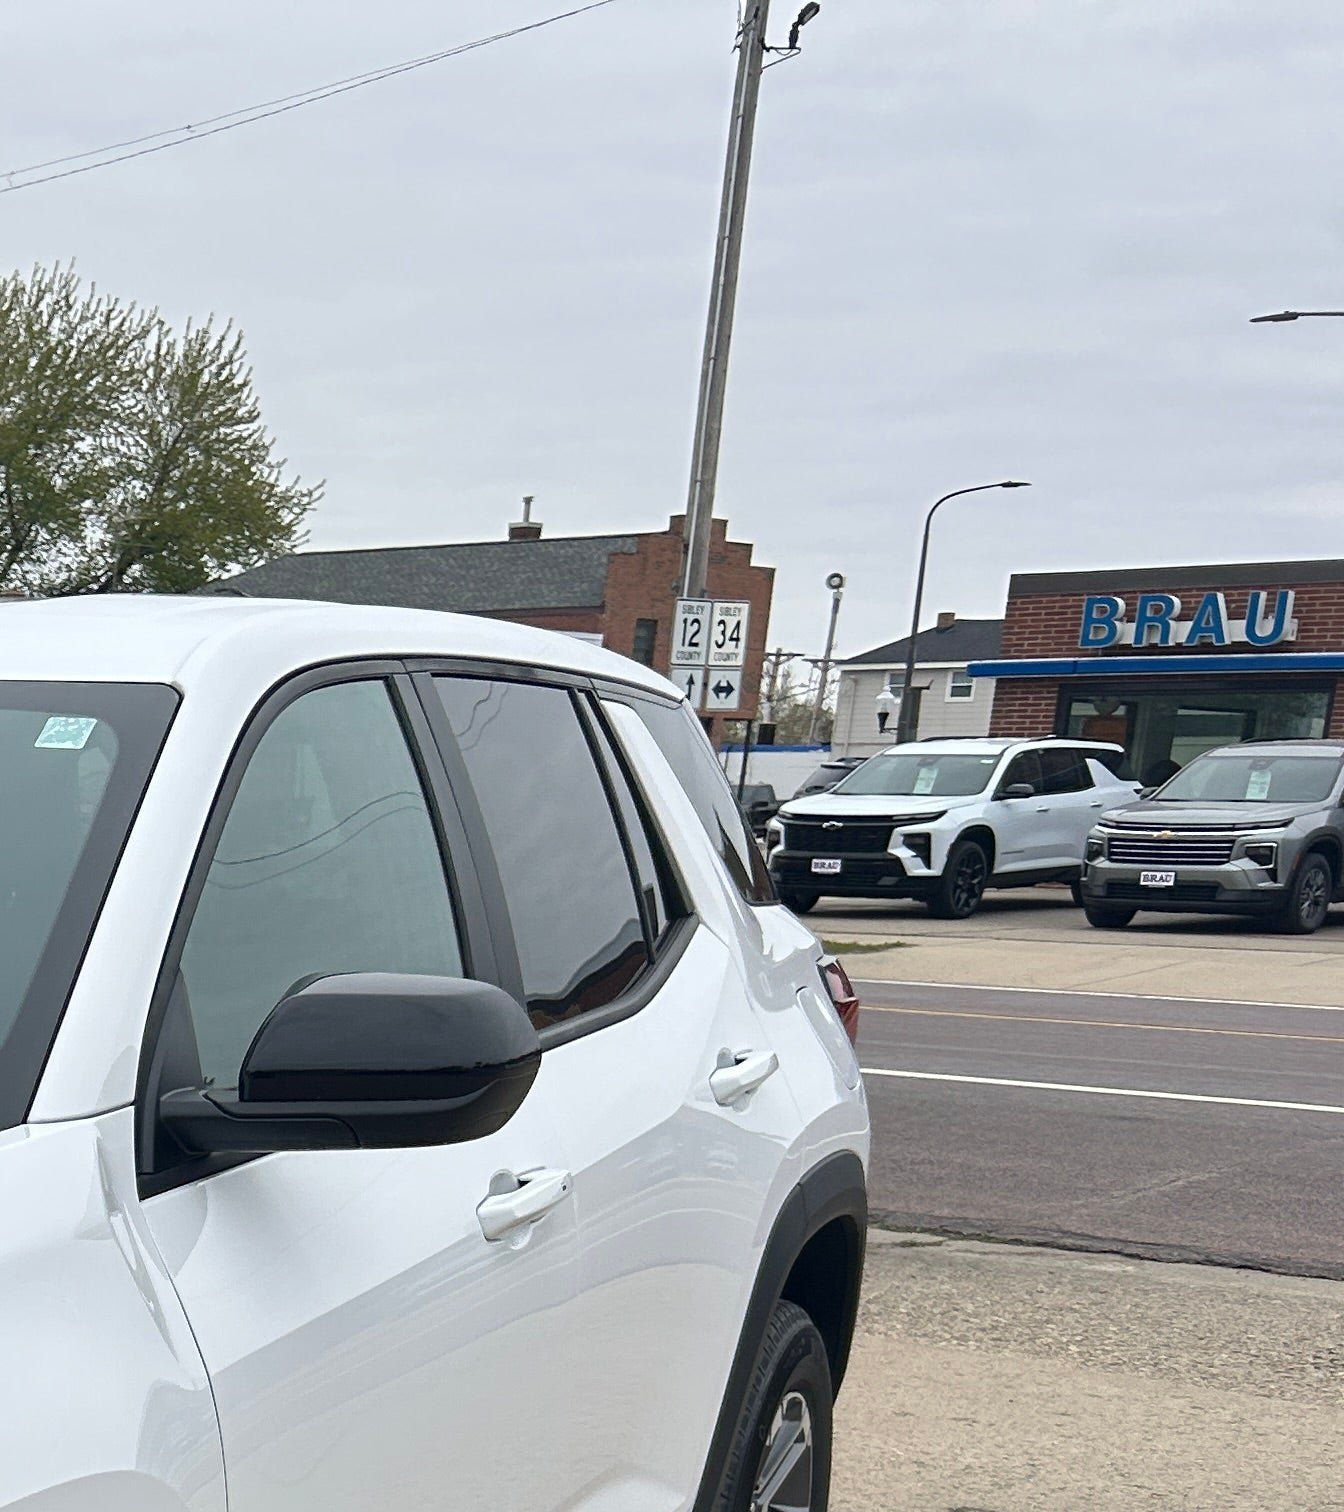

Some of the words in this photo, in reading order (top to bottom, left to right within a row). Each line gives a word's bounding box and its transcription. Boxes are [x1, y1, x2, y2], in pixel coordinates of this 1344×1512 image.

[682, 605, 705, 615] SIBLEY
[719, 606, 742, 616] SIBLEY
[1078, 590, 1296, 648] BRAU
[682, 617, 701, 647] 12
[715, 619, 741, 649] 34
[676, 651, 701, 660] COUNTY
[714, 652, 739, 661] COUNTY
[1142, 874, 1173, 882] BRAU
